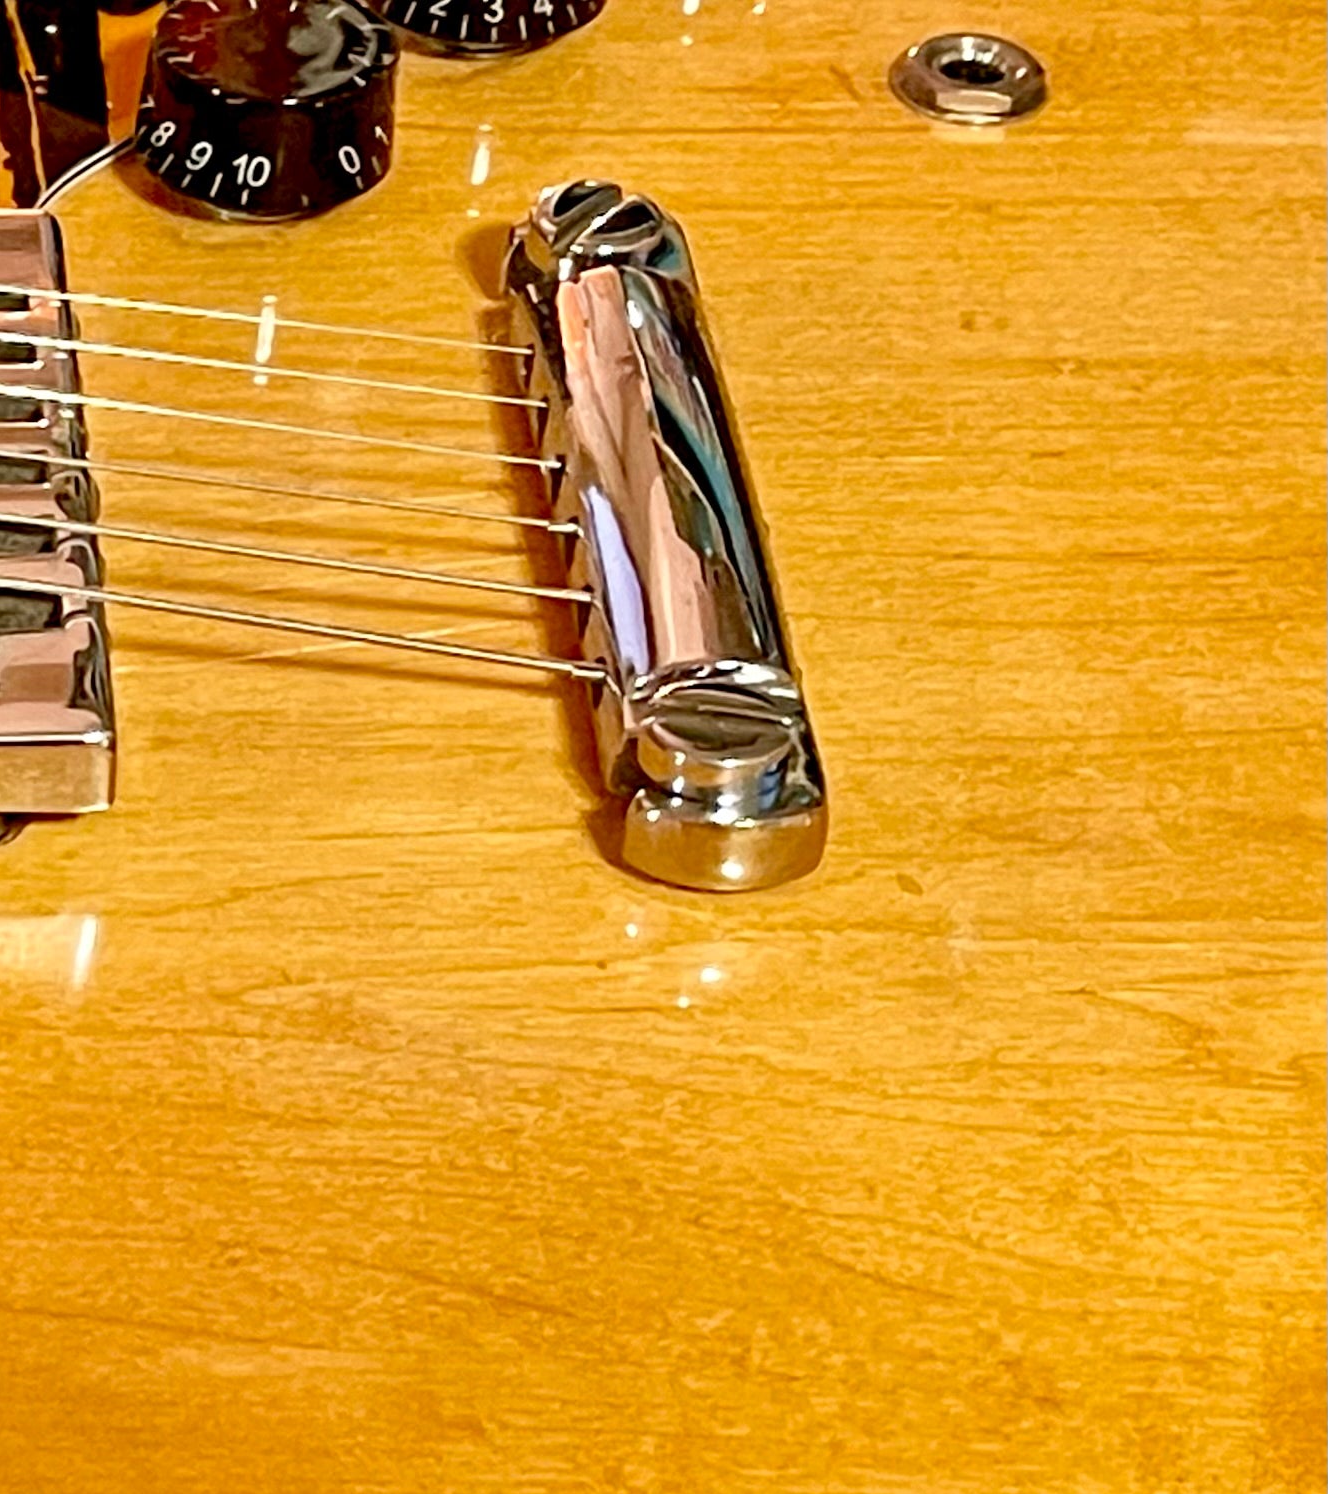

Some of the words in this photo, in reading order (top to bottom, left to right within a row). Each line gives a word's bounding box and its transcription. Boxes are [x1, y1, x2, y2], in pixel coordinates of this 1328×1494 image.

[150, 121, 177, 148] 8
[185, 141, 213, 171] 9
[232, 153, 272, 187] 10
[338, 145, 362, 175] 0
